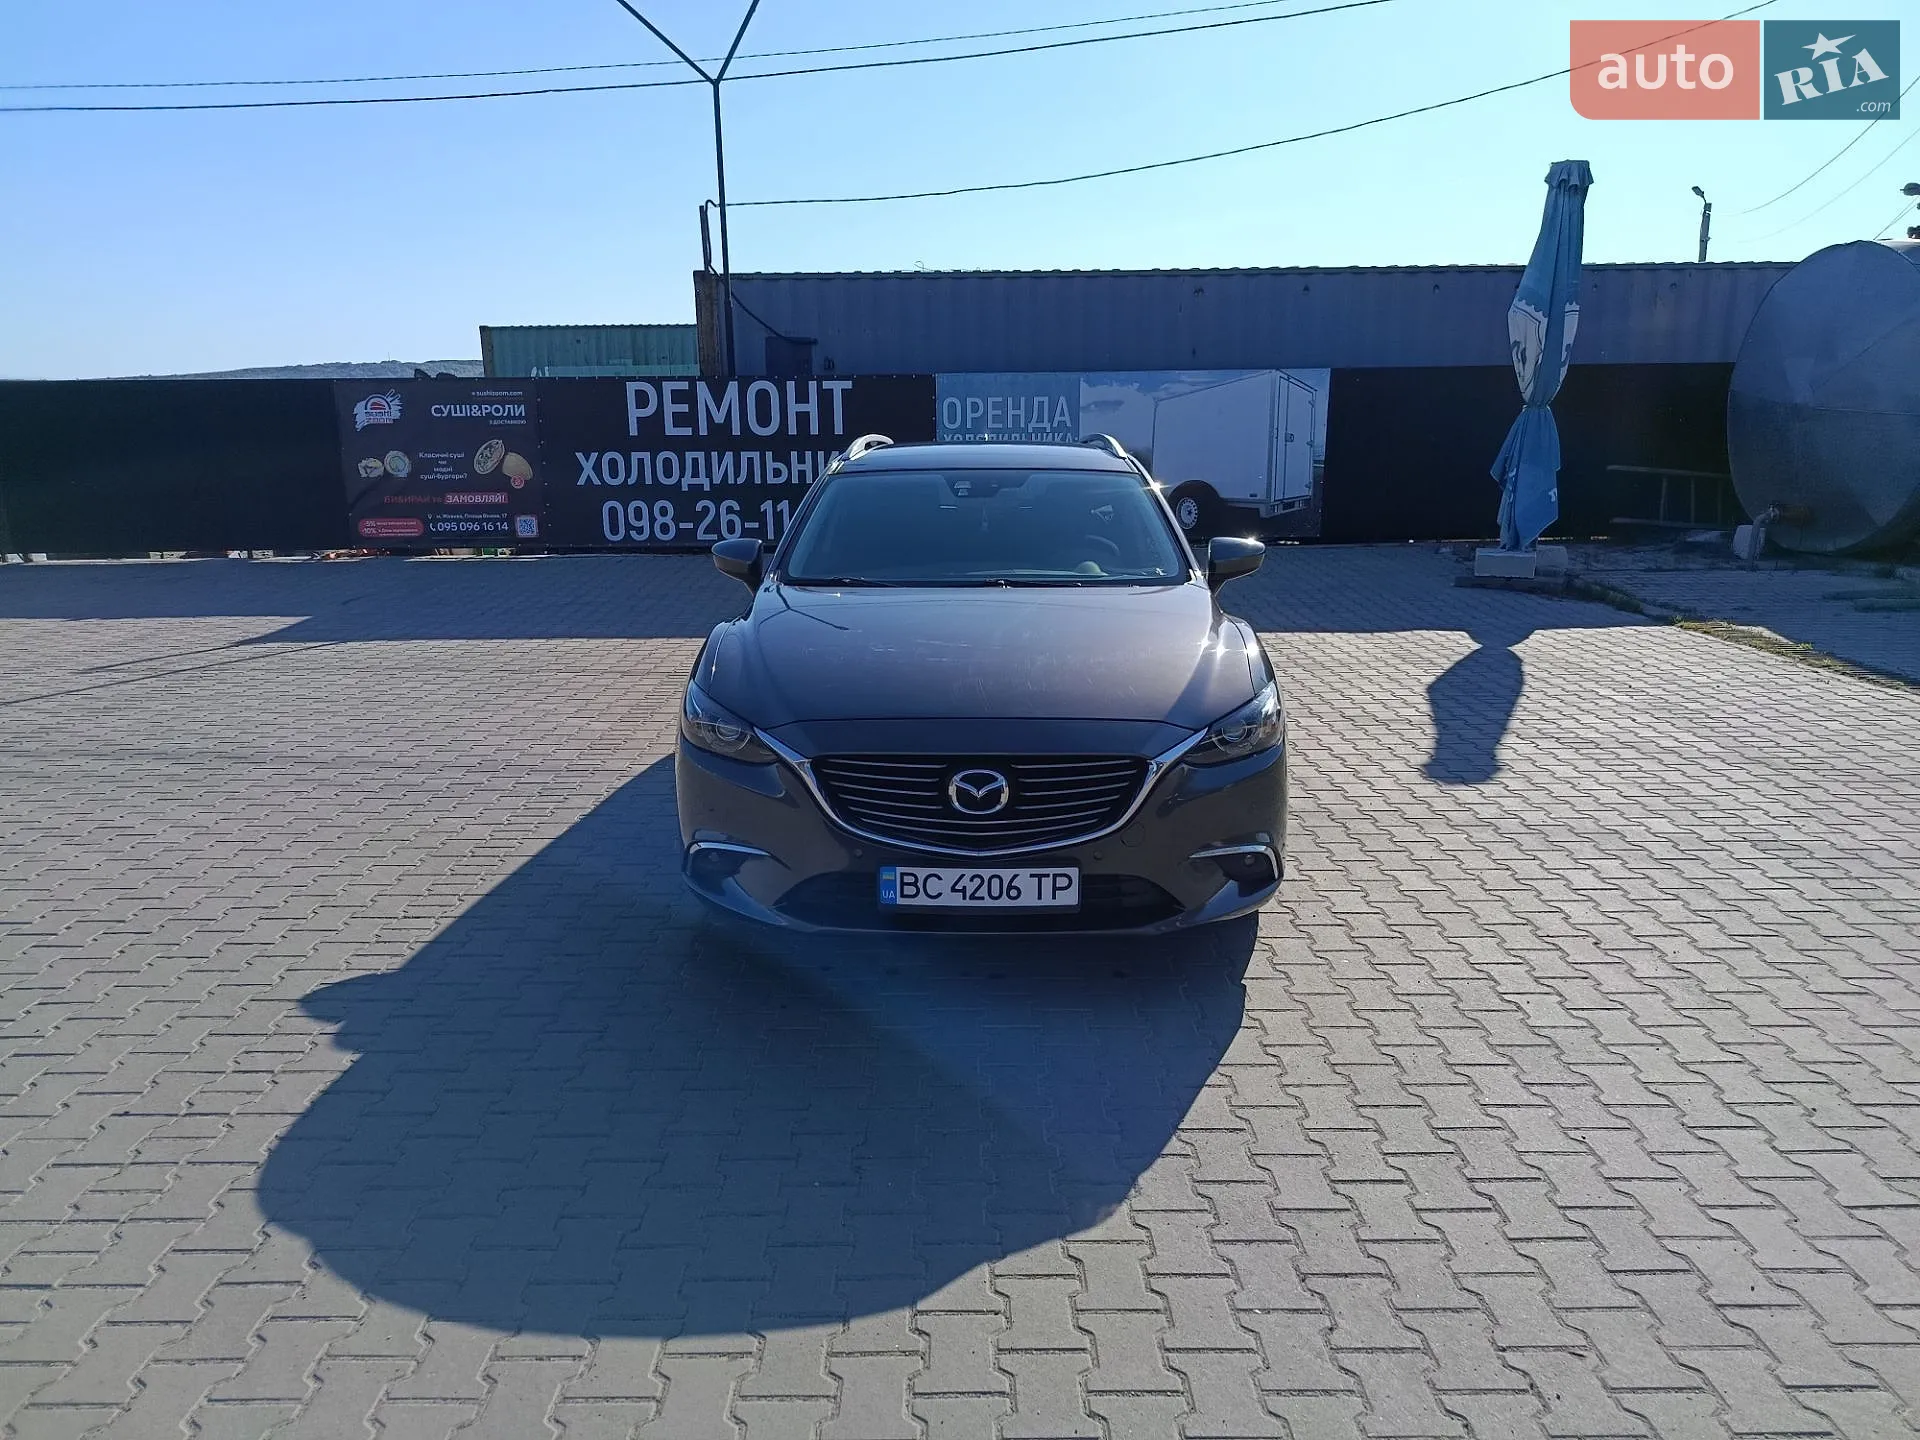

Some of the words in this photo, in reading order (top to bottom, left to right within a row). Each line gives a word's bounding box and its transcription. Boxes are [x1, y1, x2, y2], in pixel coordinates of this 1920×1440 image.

[625, 380, 853, 437] РЕМОНТ
[942, 396, 1072, 433] ОРЕНДА
[437, 522, 458, 532] 095
[459, 522, 480, 532] 096
[482, 522, 495, 532] 16
[495, 522, 509, 532] 14
[882, 889, 896, 899] UA
[899, 872, 943, 900] BC
[950, 872, 1022, 901] 4206
[1029, 873, 1073, 901] TP
